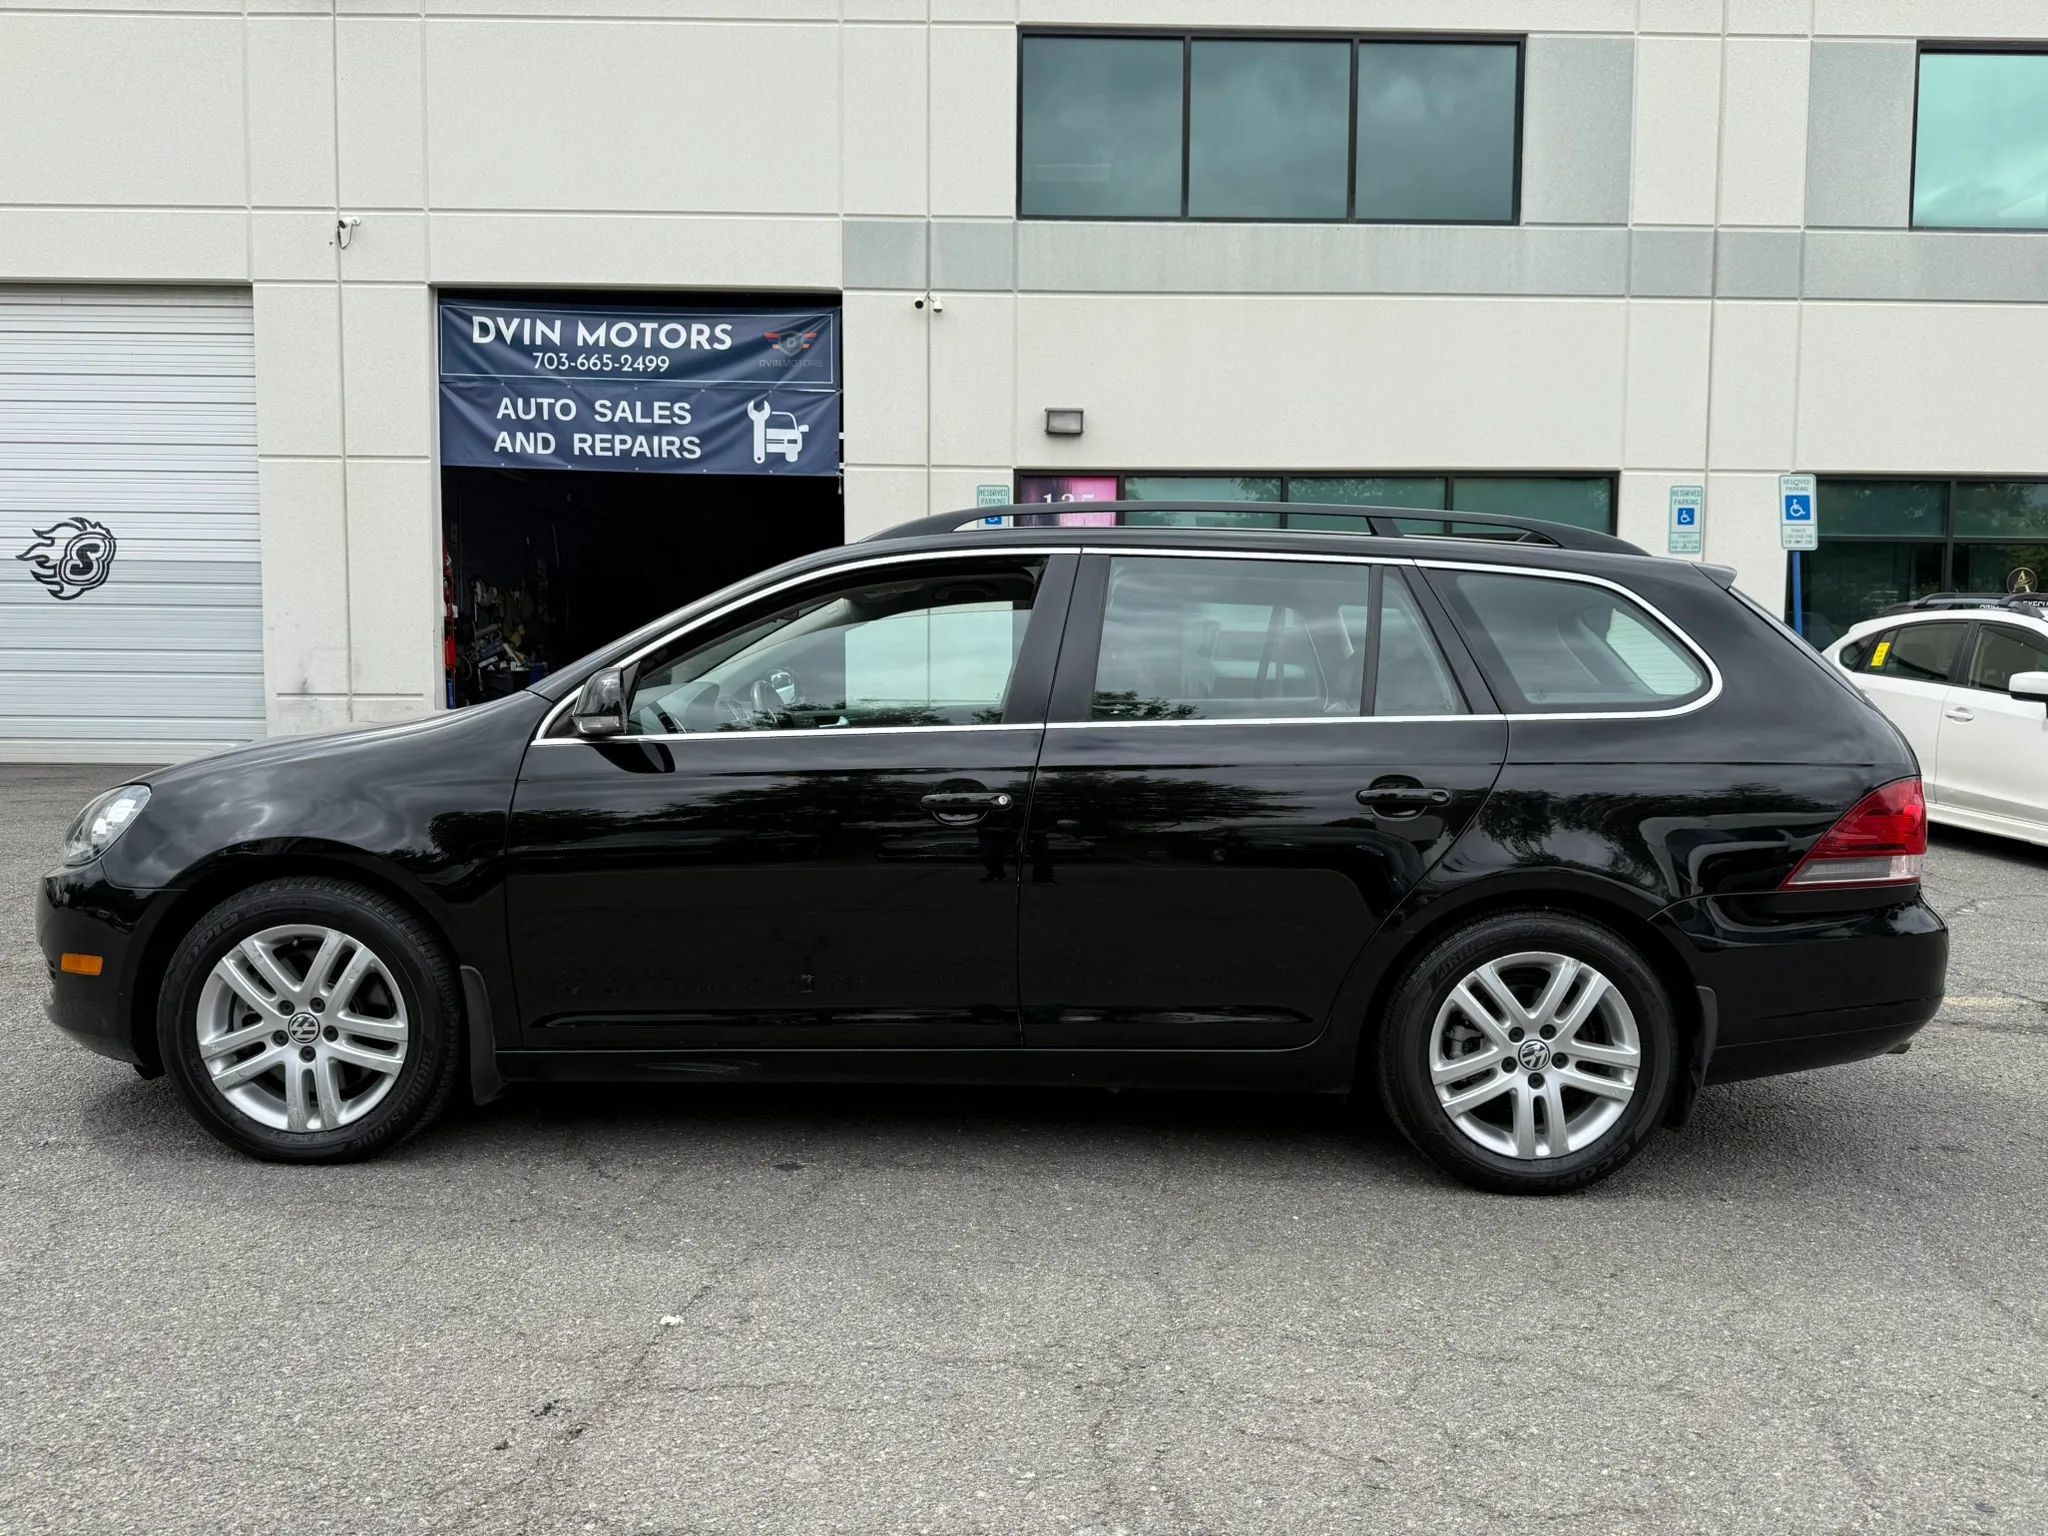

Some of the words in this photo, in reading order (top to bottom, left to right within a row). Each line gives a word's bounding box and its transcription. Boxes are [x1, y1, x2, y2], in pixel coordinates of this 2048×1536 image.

[472, 316, 561, 347] DVIN
[577, 320, 732, 350] MOTORS
[533, 352, 669, 373] 703-665-2499
[497, 397, 577, 421] AUTO
[594, 399, 692, 424] SALES
[494, 431, 556, 455] AND
[573, 434, 701, 459] REPAIRS
[978, 489, 1008, 497] RESERVED
